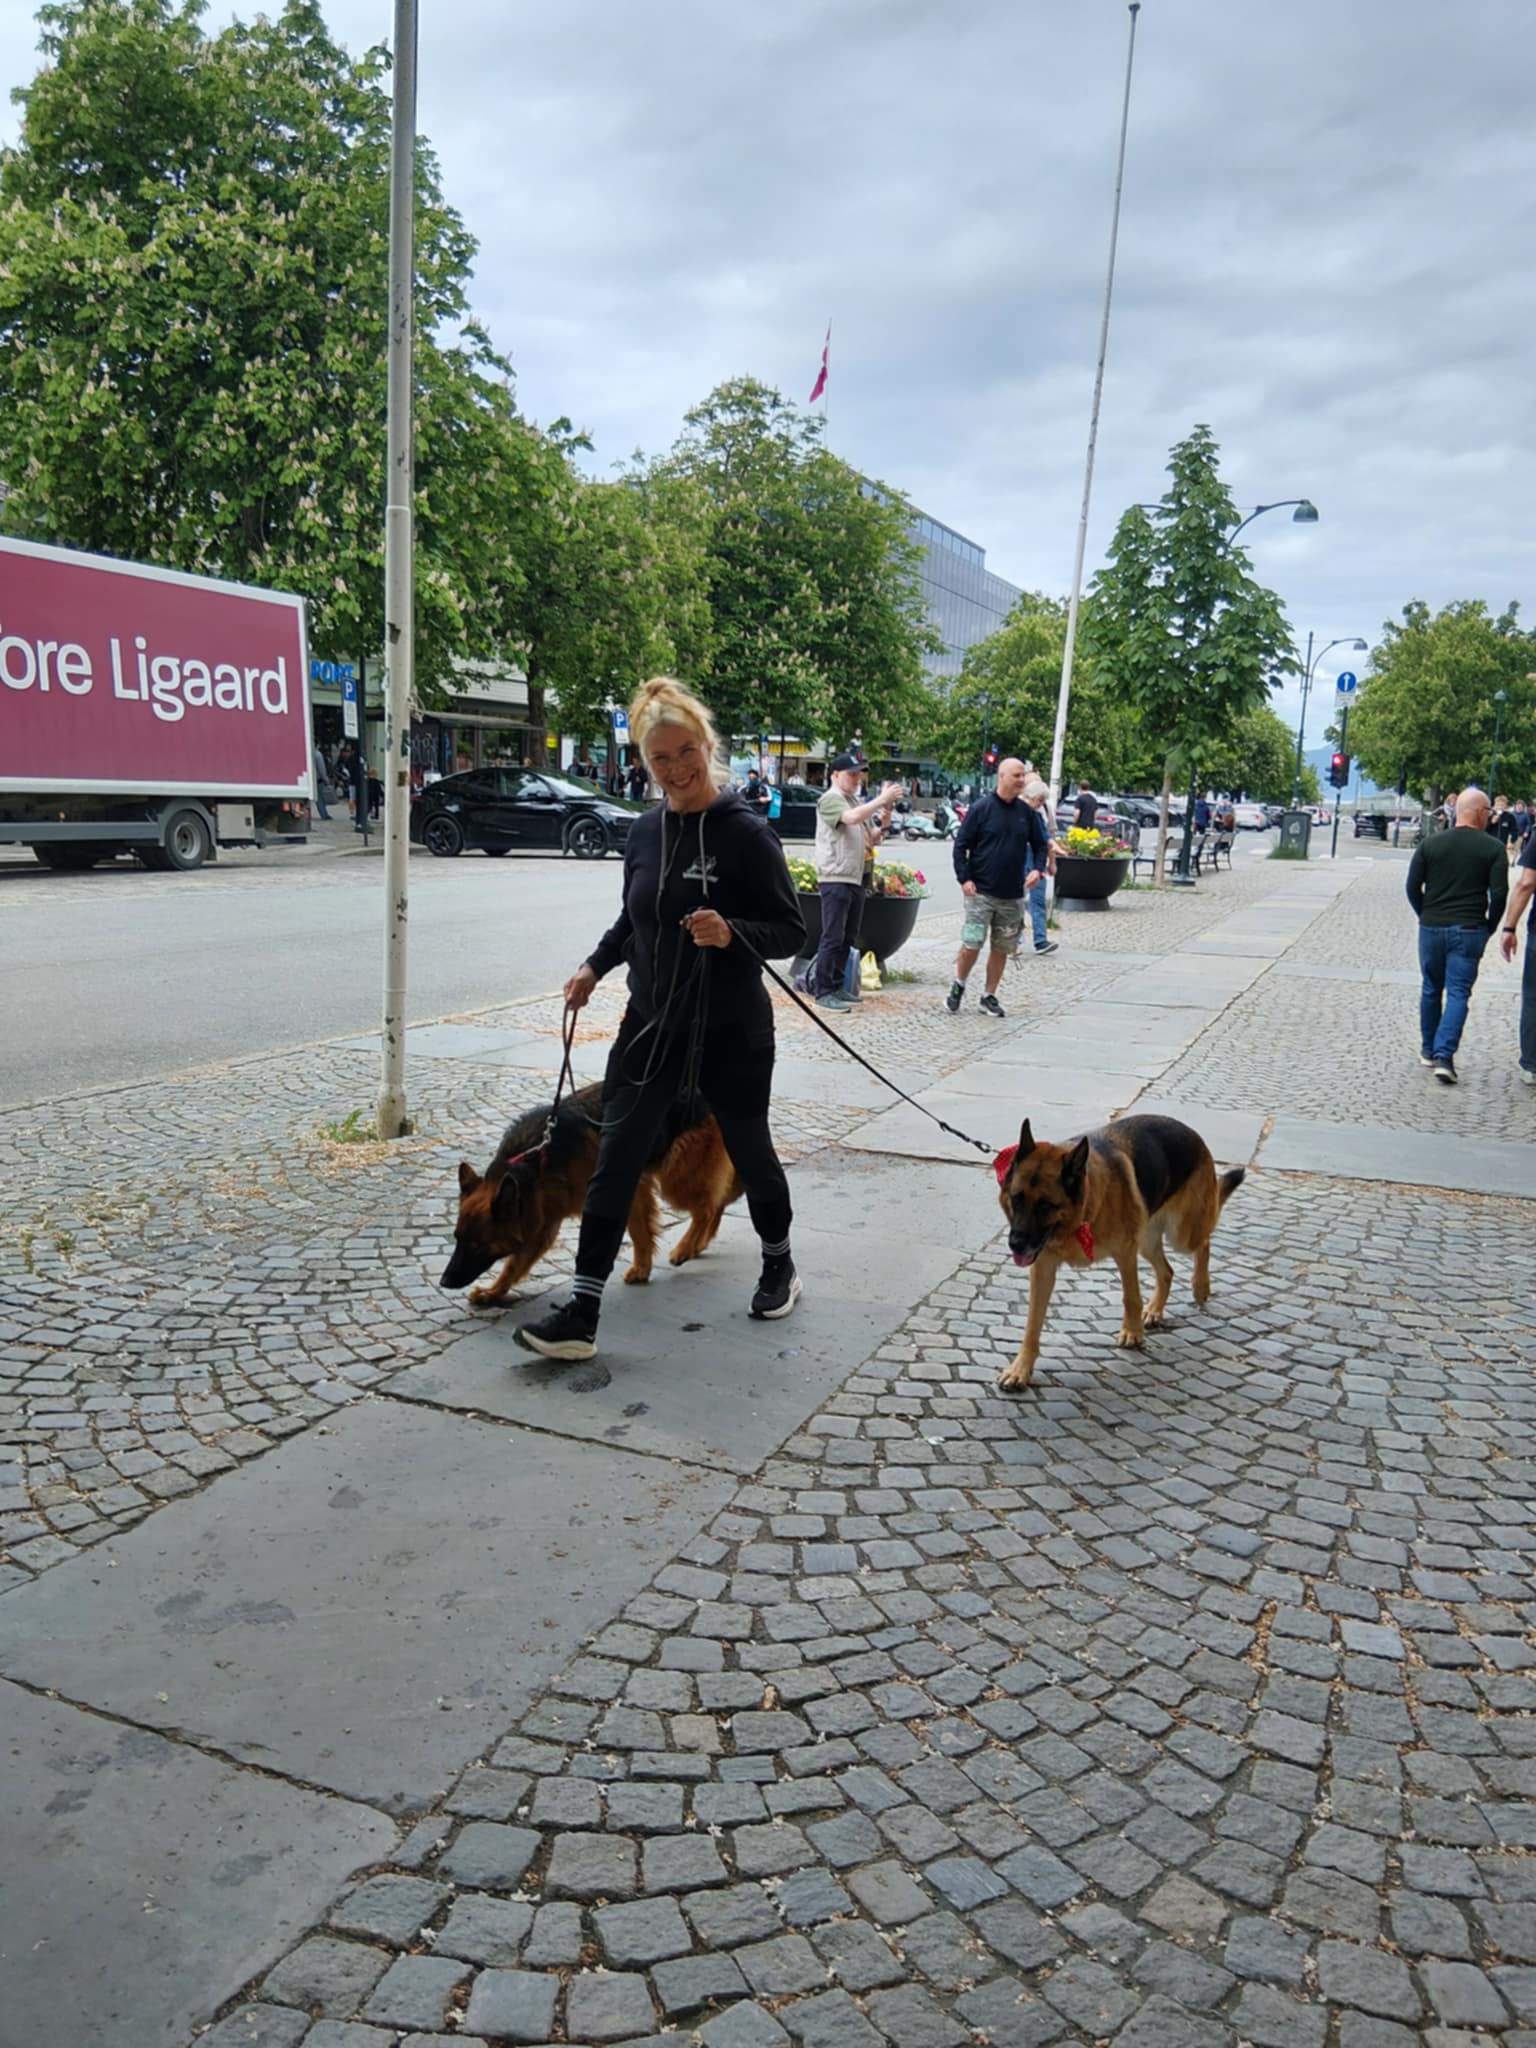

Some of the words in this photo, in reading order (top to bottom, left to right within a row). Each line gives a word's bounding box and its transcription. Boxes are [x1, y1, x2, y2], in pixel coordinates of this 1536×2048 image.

[0, 624, 93, 695] ore
[110, 636, 288, 721] Ligaard
[345, 681, 353, 698] P
[616, 713, 624, 726] P
